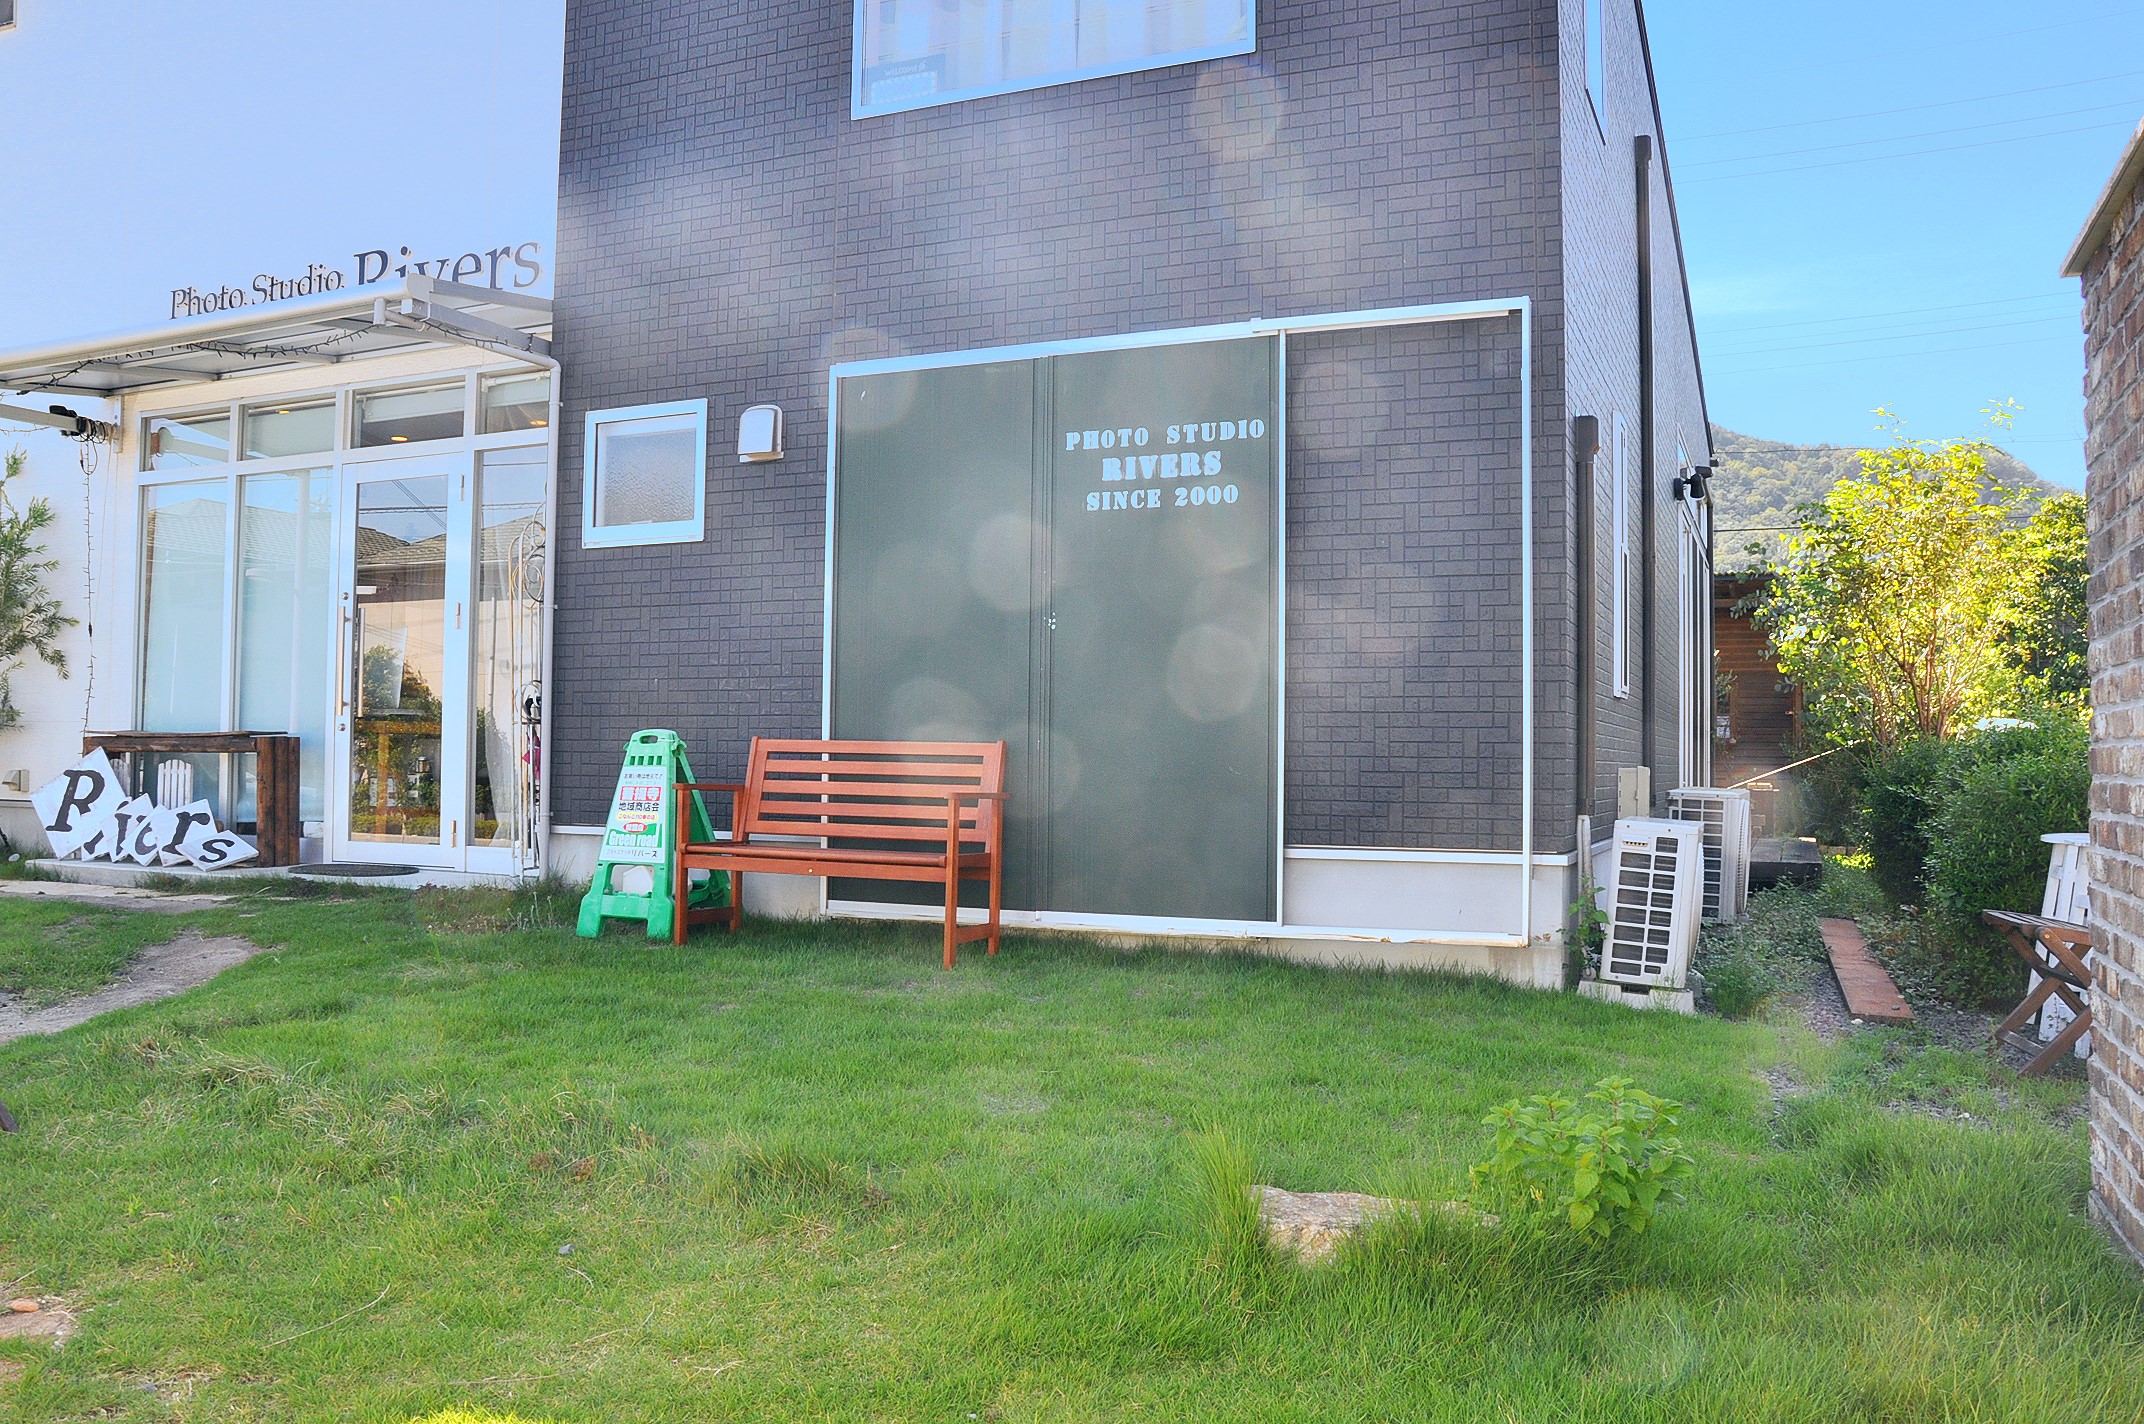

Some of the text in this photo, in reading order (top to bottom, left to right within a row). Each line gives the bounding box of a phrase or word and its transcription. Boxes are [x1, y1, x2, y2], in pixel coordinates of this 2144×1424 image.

[169, 285, 244, 320] Photo
[252, 264, 342, 305] Studio
[1066, 419, 1265, 450] PHOTO STUDIO
[1101, 450, 1222, 481] RIVERS
[1086, 484, 1239, 511] SINCE 2000
[619, 802, 660, 812] 地域商店会
[609, 831, 636, 847] Green
[638, 827, 660, 847] road
